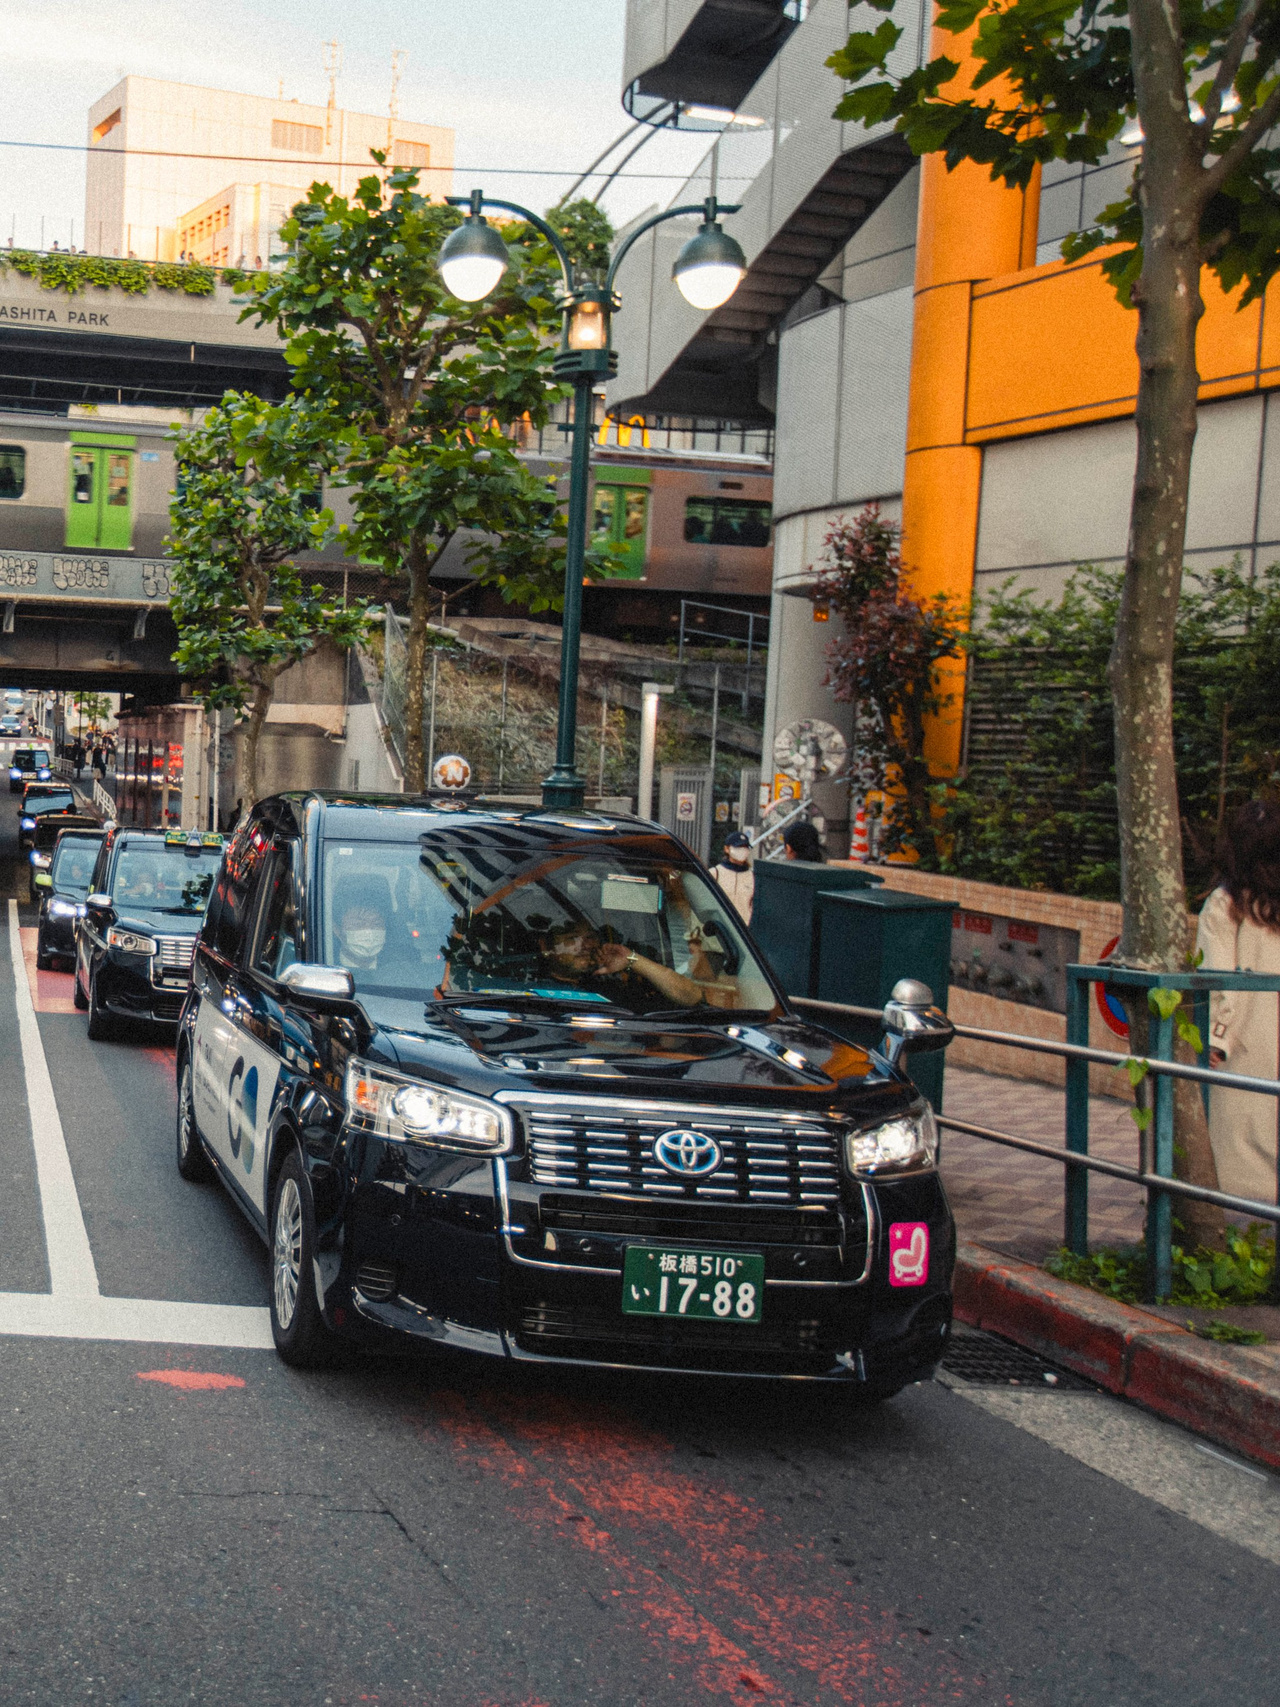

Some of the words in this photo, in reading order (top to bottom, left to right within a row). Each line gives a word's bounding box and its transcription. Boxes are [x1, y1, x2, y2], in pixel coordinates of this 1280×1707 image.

[68, 311, 110, 326] PARK
[631, 1284, 650, 1300] い
[659, 1276, 755, 1318] 17-88
